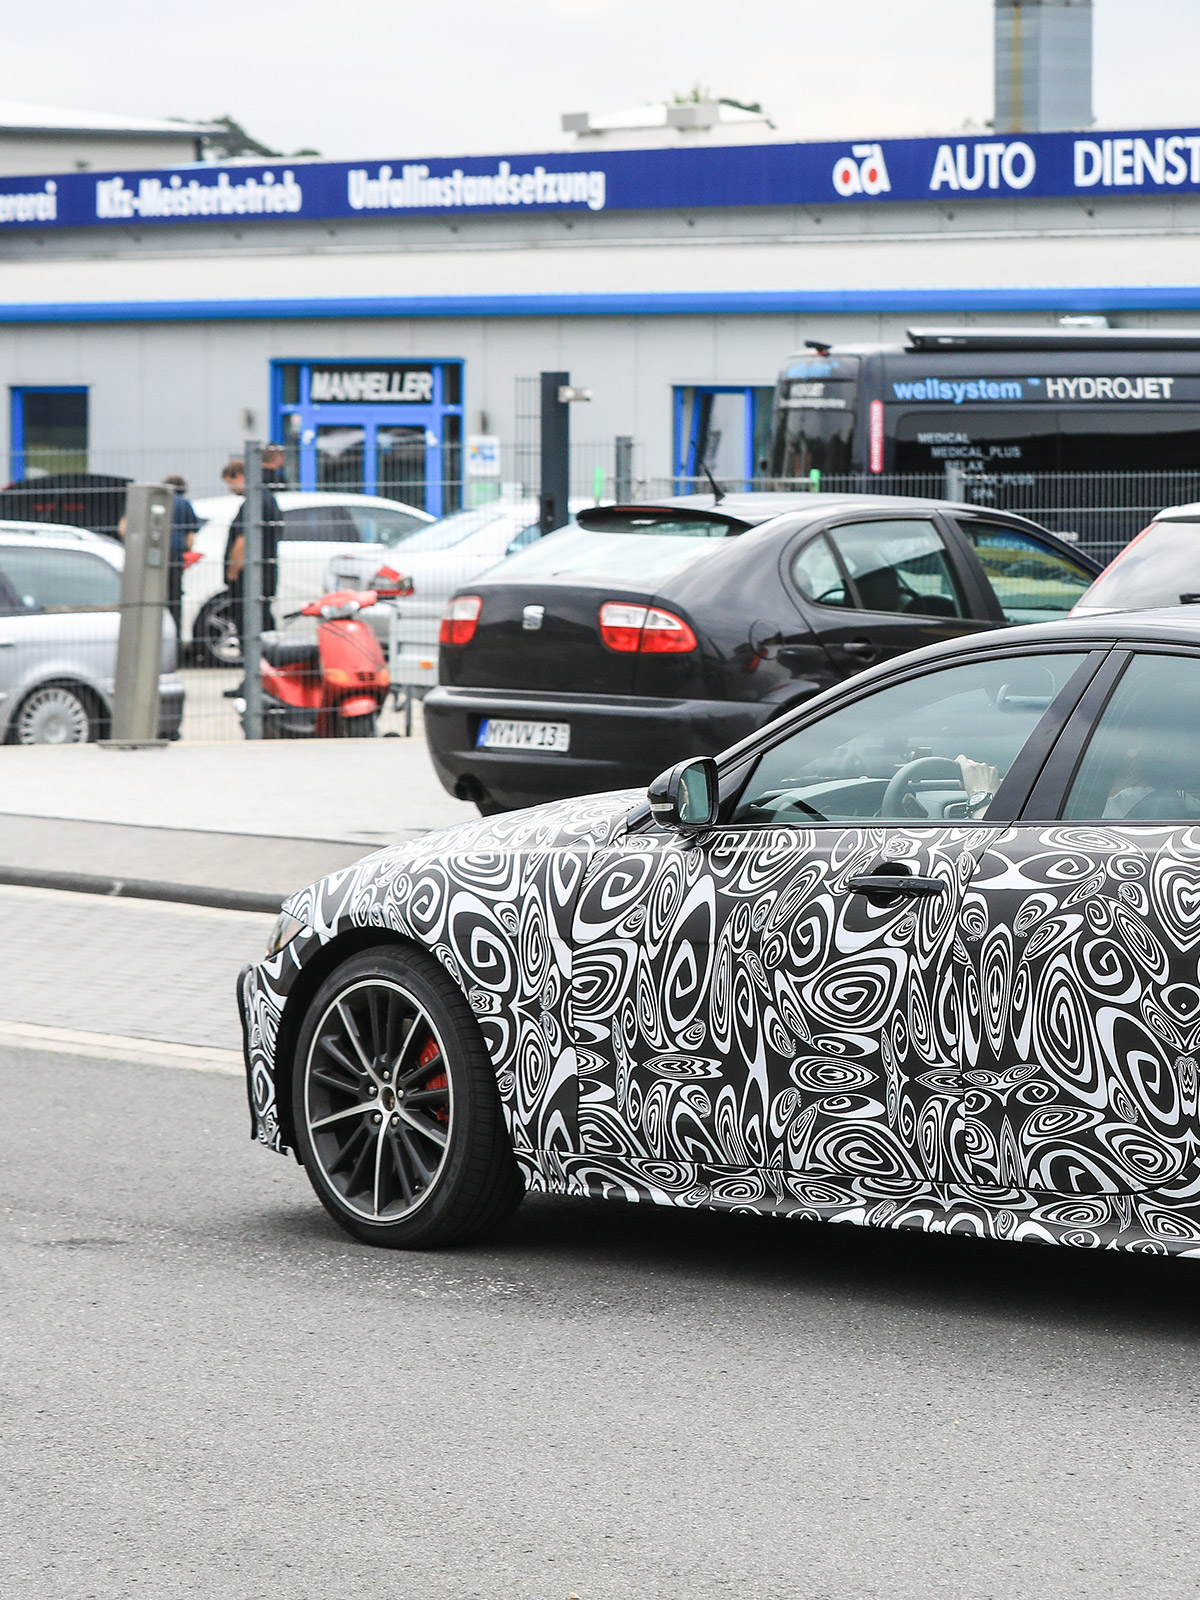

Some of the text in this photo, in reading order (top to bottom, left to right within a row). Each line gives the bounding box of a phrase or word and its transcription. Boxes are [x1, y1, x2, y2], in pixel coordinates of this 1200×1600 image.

[929, 141, 1036, 190] AUTO
[96, 169, 302, 219] Kfz-Meisterbetrieb
[348, 161, 605, 211] Unfallinstandsetzung
[311, 371, 433, 401] MANHELLER
[892, 378, 1022, 404] wellsystem
[1046, 377, 1174, 399] HYDROJET
[917, 432, 969, 443] MEDICAL
[538, 726, 558, 746] 13
